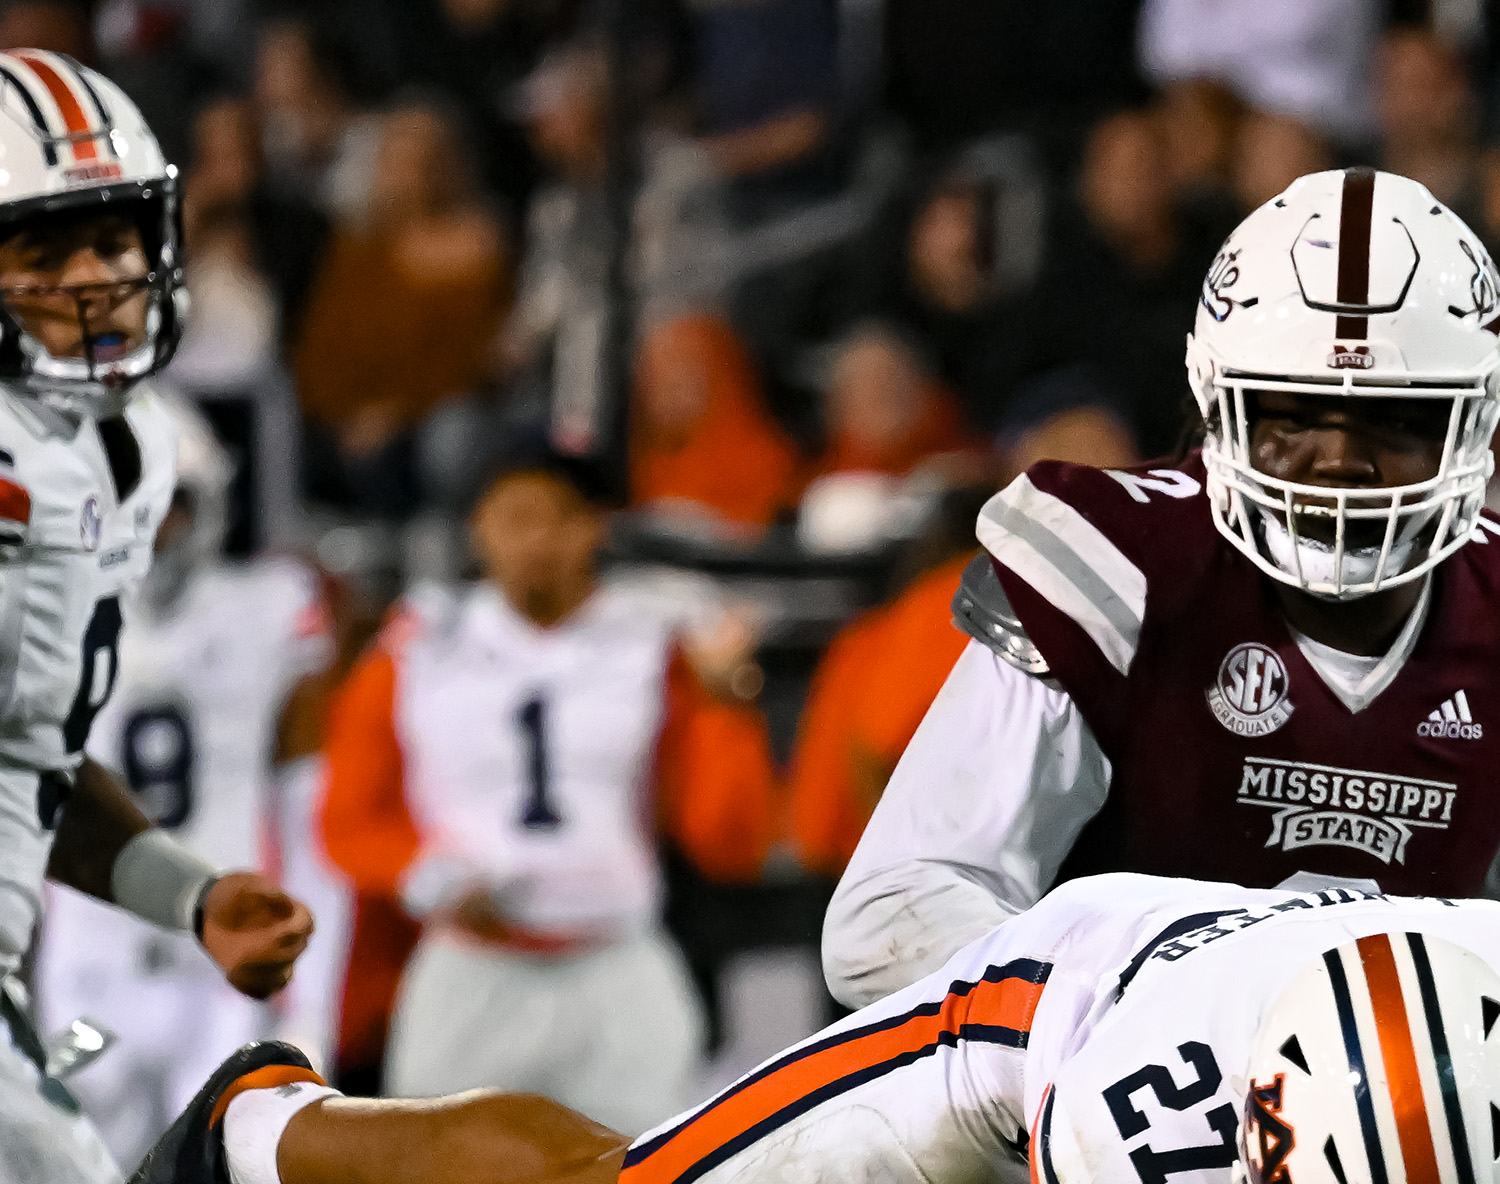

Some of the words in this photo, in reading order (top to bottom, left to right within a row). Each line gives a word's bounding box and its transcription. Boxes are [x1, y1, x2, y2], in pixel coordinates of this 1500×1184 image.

[1225, 649, 1282, 713] SEC
[1213, 698, 1282, 735] GRADUATE
[1417, 719, 1484, 740] adidas
[514, 695, 562, 827] 1
[1237, 764, 1458, 821] MISSISSIPPI
[1296, 817, 1392, 854] STATE
